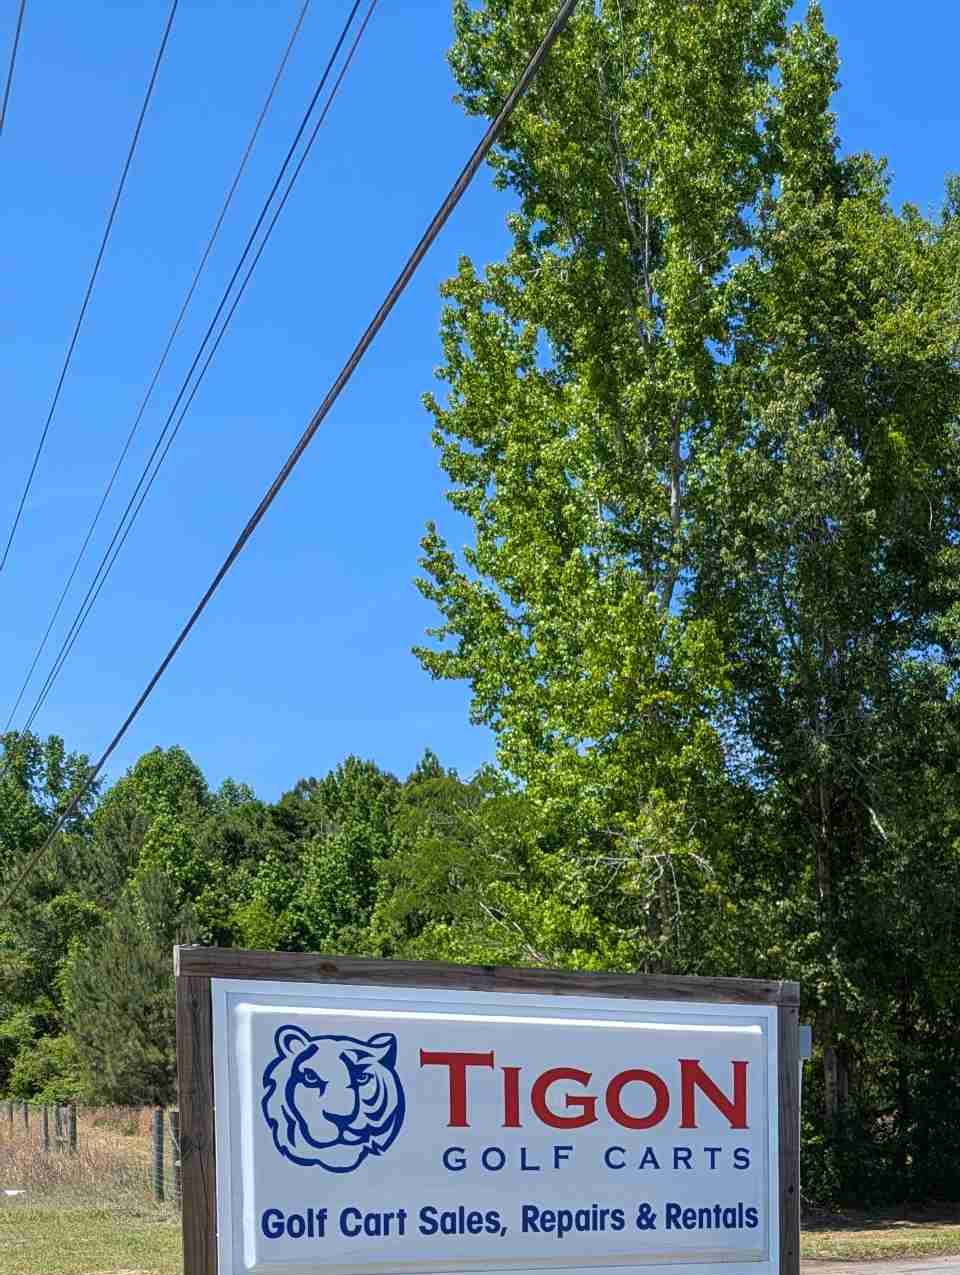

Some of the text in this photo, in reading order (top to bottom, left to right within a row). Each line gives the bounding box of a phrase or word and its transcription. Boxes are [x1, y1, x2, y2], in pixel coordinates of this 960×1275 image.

[419, 1047, 751, 1131] TIGON
[442, 1145, 752, 1172] GOLF CARTS
[260, 1200, 760, 1240] Golf Cart Sales, Repairs & Rentals
